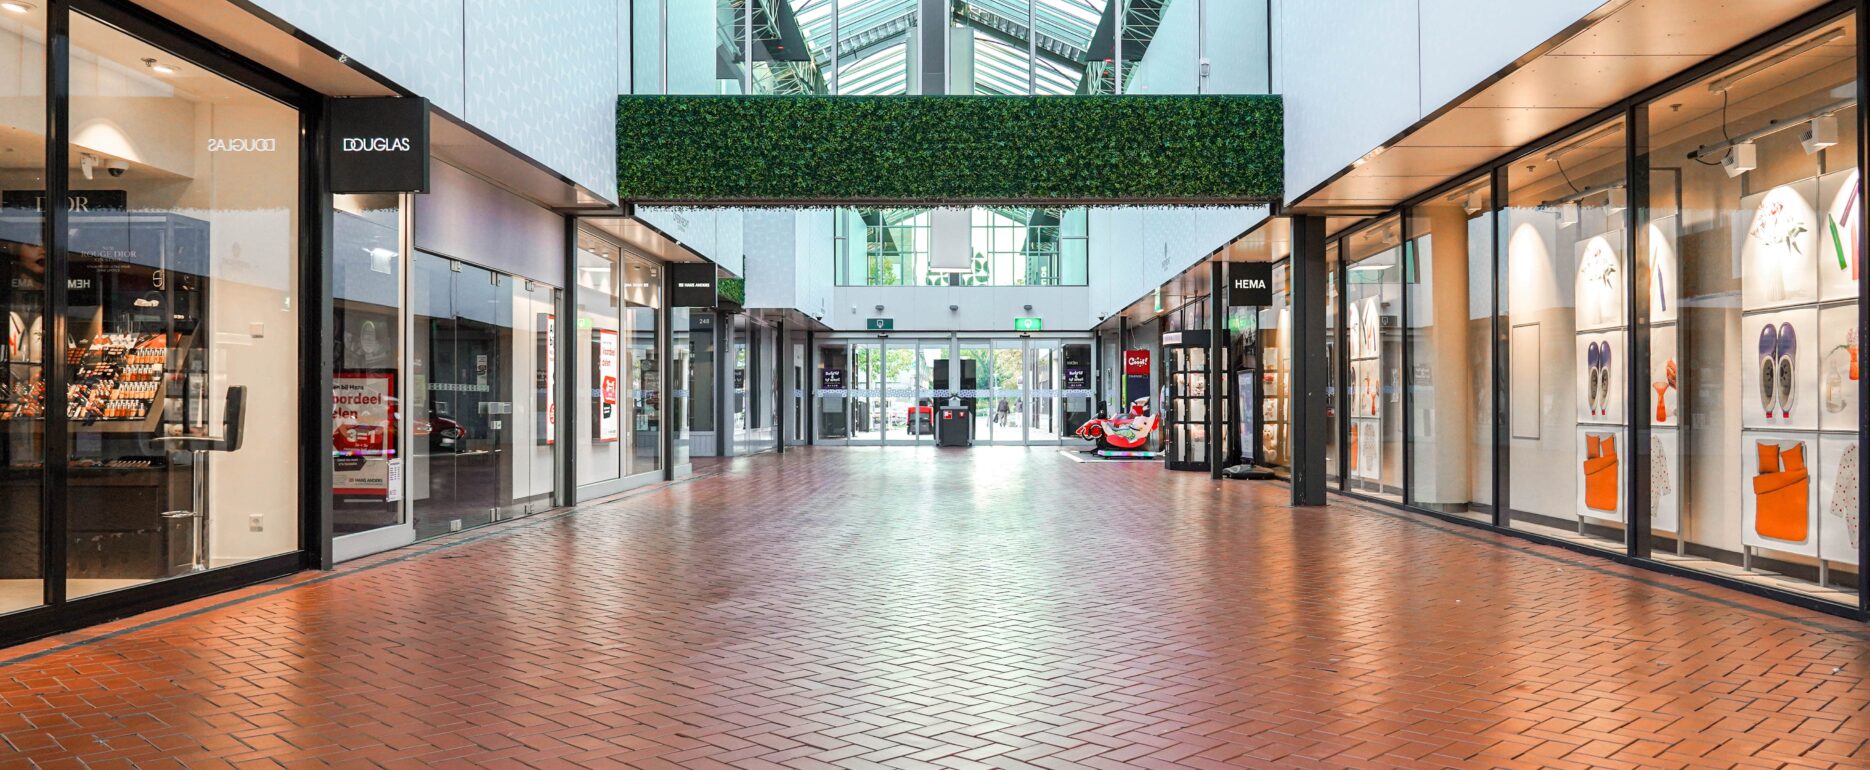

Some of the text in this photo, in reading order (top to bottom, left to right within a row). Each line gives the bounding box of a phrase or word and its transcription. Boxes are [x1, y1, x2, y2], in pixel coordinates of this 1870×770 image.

[342, 137, 411, 152] DOUGLAS
[36, 196, 89, 213] DR
[81, 250, 137, 258] ROUGE DIOR
[1234, 279, 1266, 289] HEMA
[346, 429, 376, 444] 3=1
